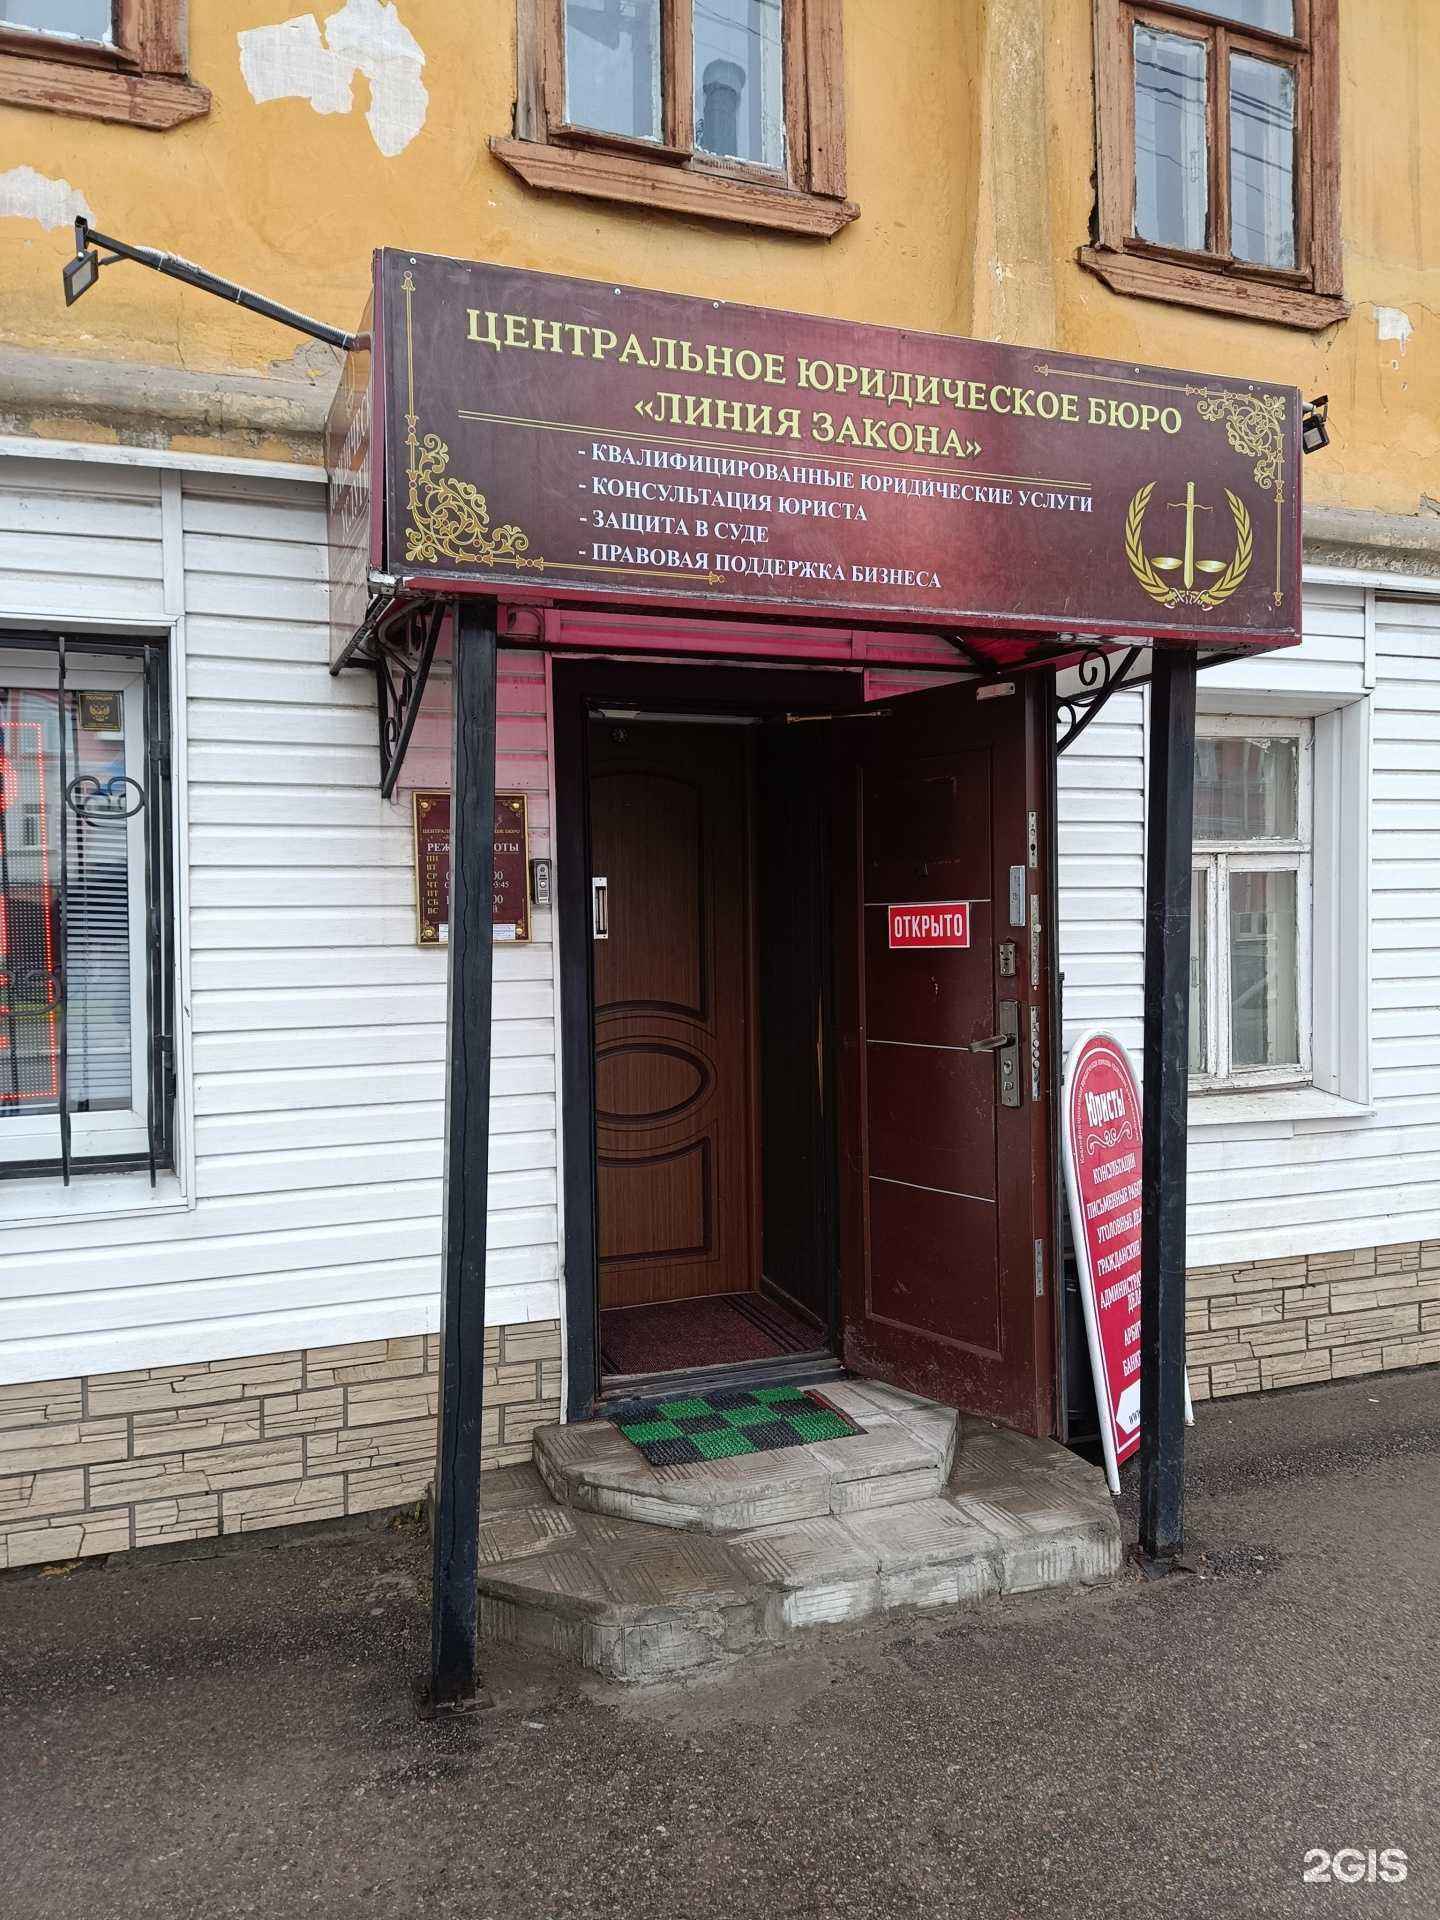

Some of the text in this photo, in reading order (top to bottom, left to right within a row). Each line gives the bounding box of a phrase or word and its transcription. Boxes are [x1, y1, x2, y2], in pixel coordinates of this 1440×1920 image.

[466, 308, 1182, 434] ЦЕНТРАЛЬНОЕ ЮРИДИЧЕСКОЕ БЮРО
[634, 391, 982, 457] «ЛИНИЯ ЗАКОНА»
[591, 442, 855, 489] КВАЛИФИЦИРОВАННЫЕ
[860, 473, 1013, 505] ЮРИДИЧЕСКИЕ
[1018, 490, 1094, 512] УСЛУГИ
[591, 476, 772, 513] КОНСУЛЬТАЦИЯ
[778, 496, 868, 521] ЮРИСТА
[592, 510, 690, 535] ЗАЩИТА
[695, 520, 709, 537] В
[714, 522, 769, 544] СУДЕ
[592, 542, 709, 570] ПРАВОВАЯ
[715, 553, 846, 581] ПОДДЕРЖКА
[852, 565, 942, 588] БИЗНЕСА
[427, 843, 519, 852] РЕЖ ОТЫ
[894, 913, 963, 938] ОТКРЫТО
[1085, 1088, 1126, 1127] Юристы
[1100, 1270, 1141, 1310] АДМИНИСТРА
